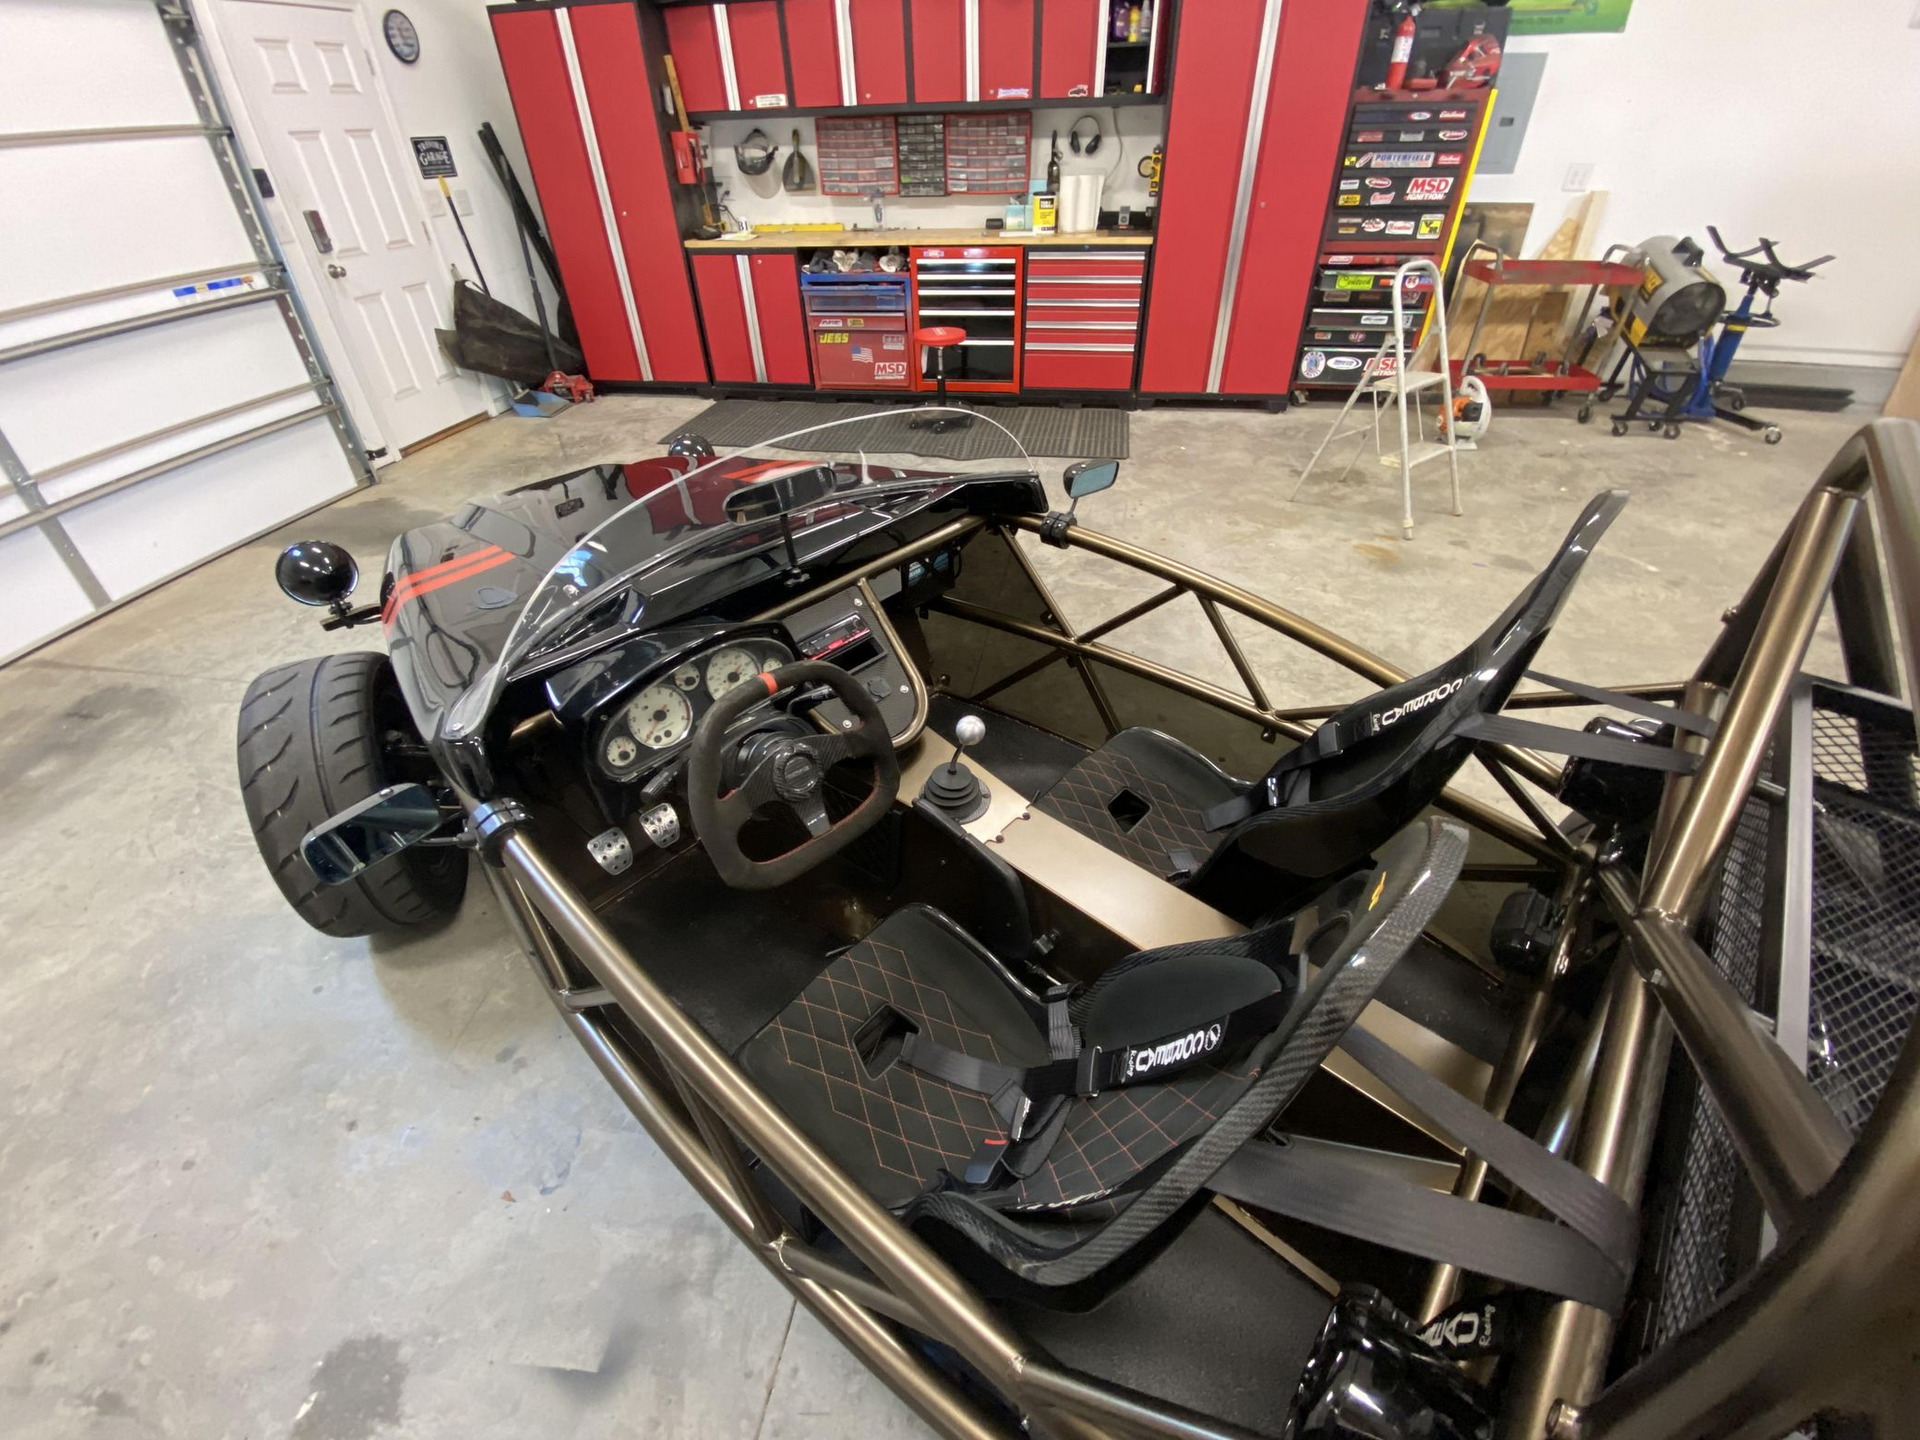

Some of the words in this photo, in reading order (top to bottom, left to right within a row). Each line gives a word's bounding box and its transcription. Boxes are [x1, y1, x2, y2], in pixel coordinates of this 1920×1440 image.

[1410, 179, 1450, 193] MSD
[1406, 193, 1444, 201] IGNITION
[819, 333, 849, 343] JEGS
[876, 364, 906, 375] MSD
[1382, 678, 1463, 726] CORBEAU
[1479, 1303, 1497, 1347] Racing
